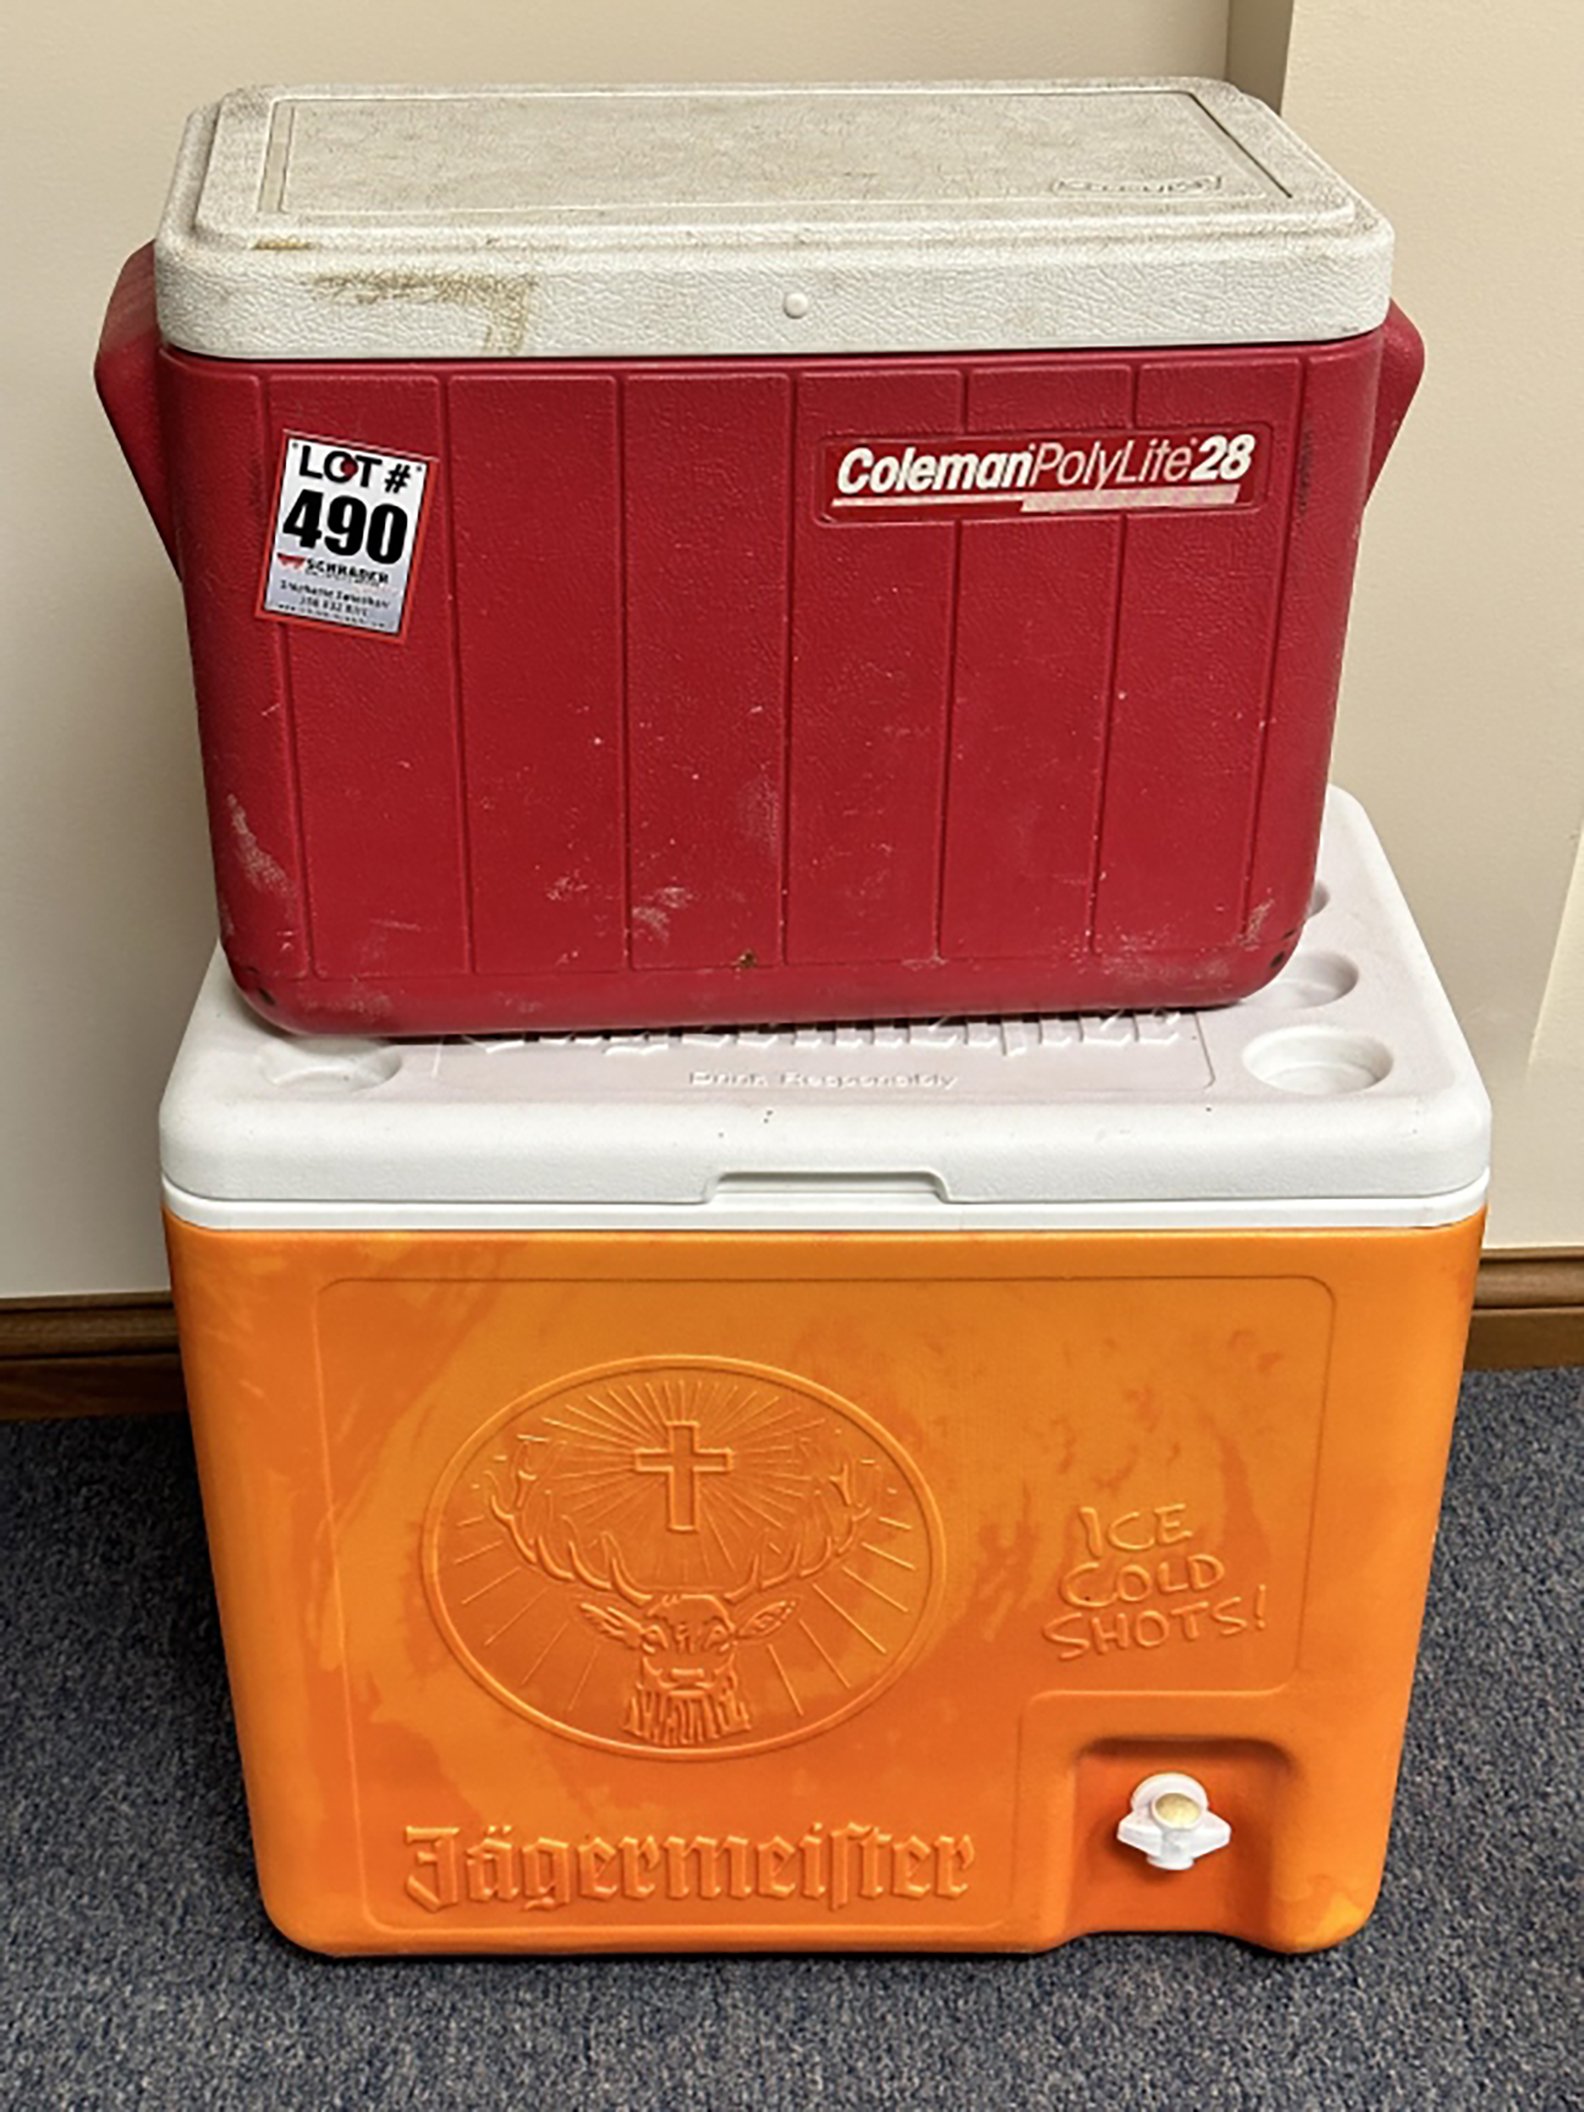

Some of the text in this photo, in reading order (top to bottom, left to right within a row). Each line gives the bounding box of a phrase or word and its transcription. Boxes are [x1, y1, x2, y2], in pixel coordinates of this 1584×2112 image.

[299, 445, 411, 494] LOT #
[836, 434, 1256, 495] Coleman PolyLite 28
[282, 488, 408, 565] 490
[1079, 1503, 1194, 1559] ICE
[1058, 1553, 1226, 1609] COLD
[1042, 1584, 1267, 1662] SHOTS!
